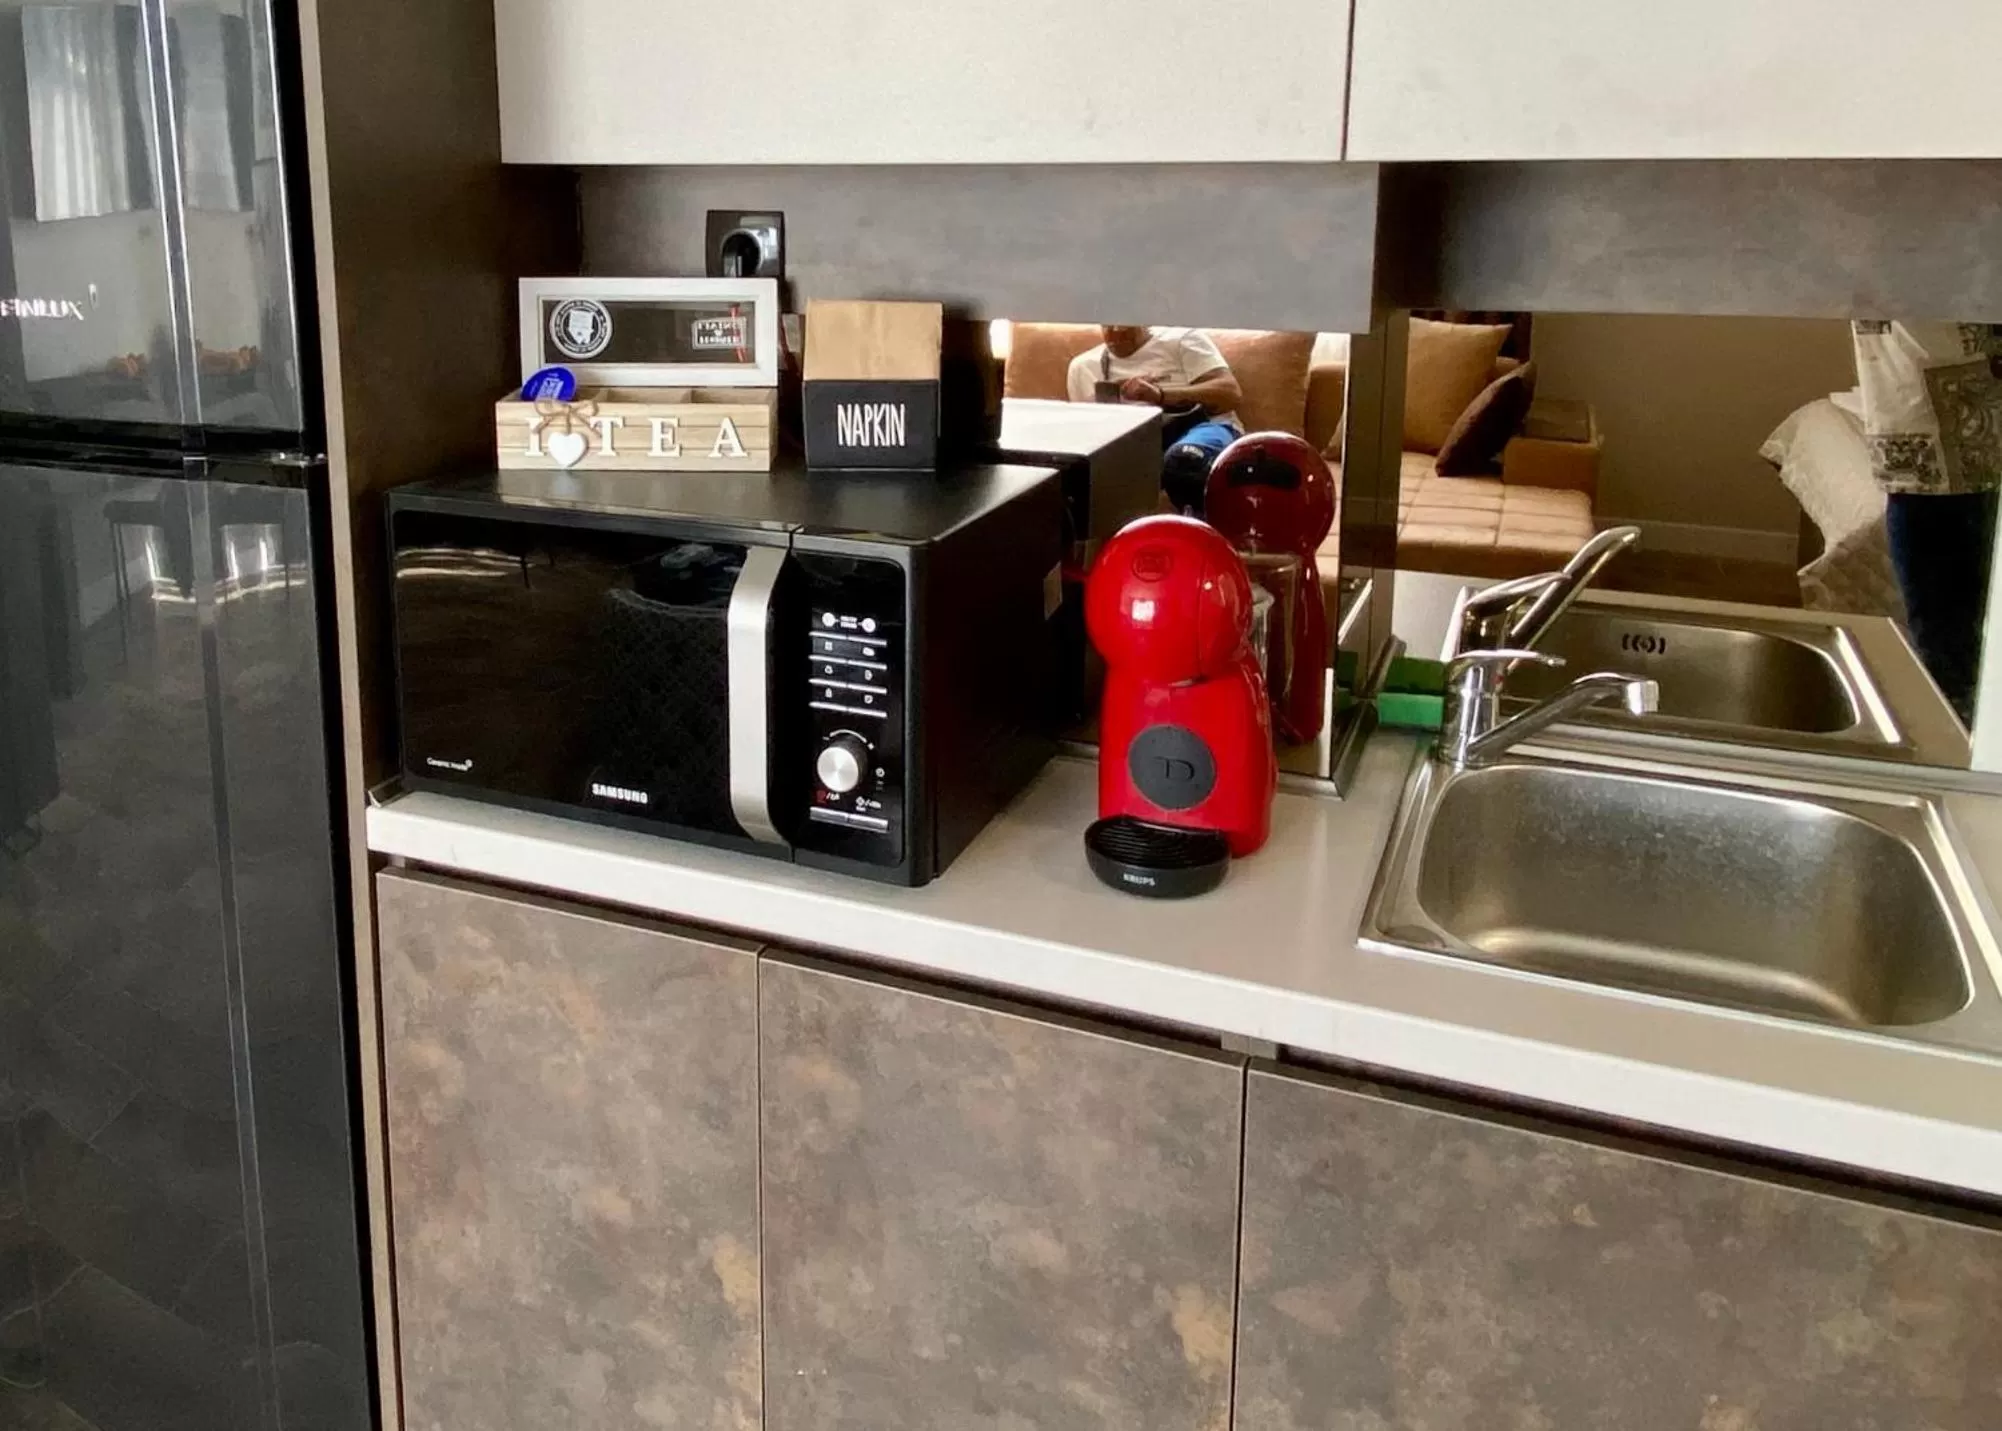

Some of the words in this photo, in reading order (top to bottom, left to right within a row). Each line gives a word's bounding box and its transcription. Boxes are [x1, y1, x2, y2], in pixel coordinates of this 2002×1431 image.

[0, 298, 84, 320] FINLUX
[837, 403, 905, 447] NAPKIN
[589, 416, 749, 458] TEA
[592, 783, 648, 804] SAMSUNG
[1122, 873, 1156, 886] KRUPS
